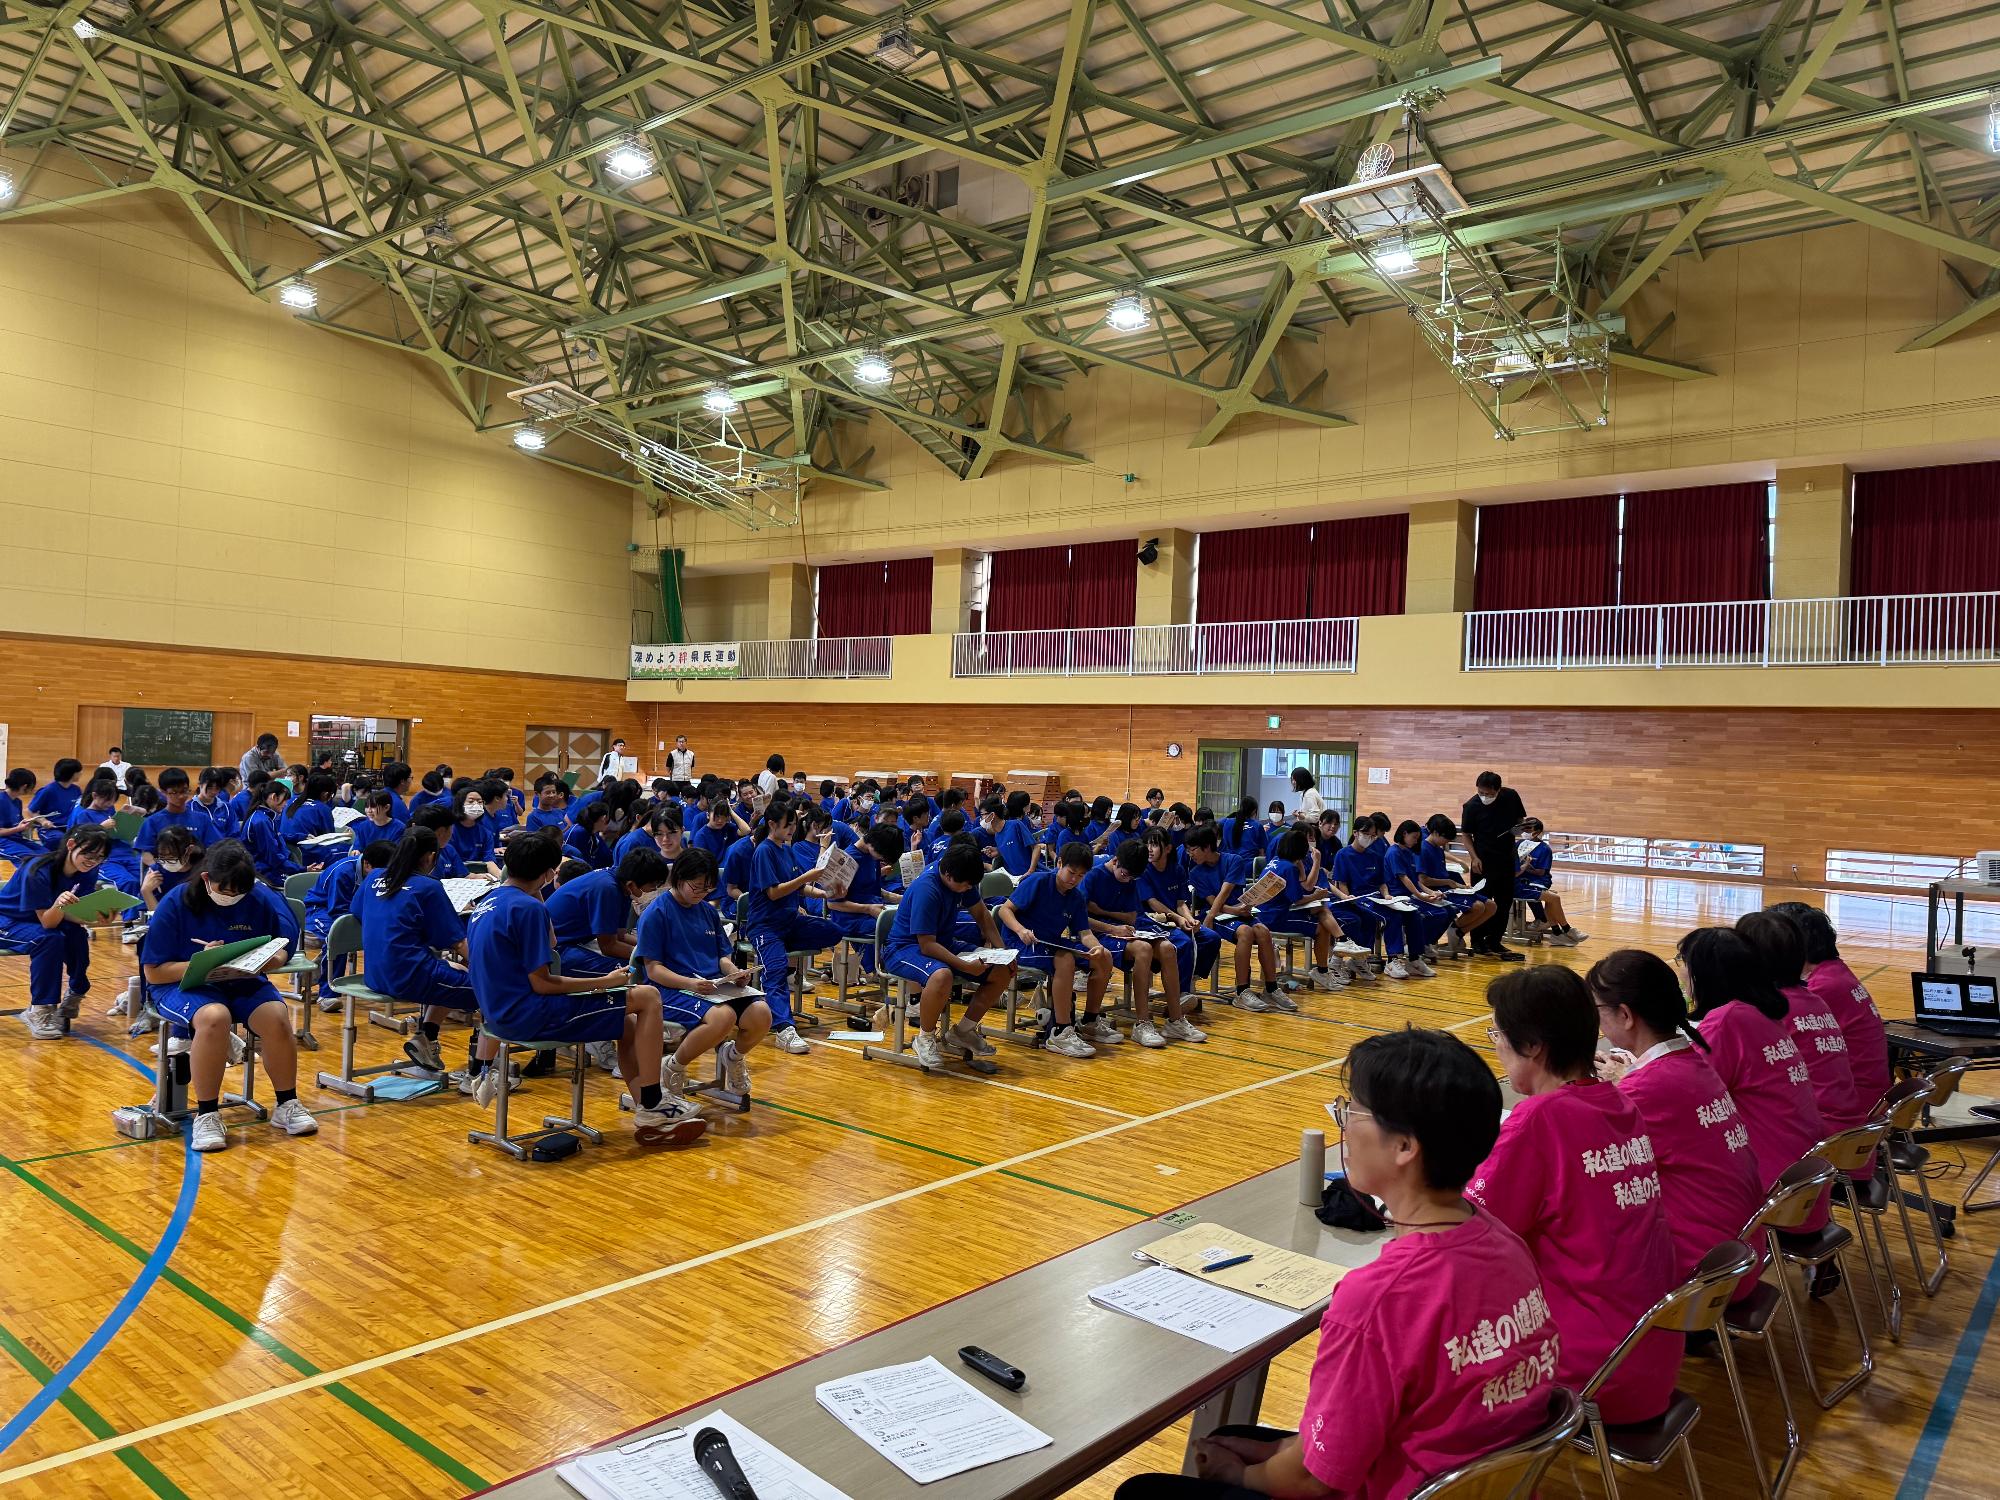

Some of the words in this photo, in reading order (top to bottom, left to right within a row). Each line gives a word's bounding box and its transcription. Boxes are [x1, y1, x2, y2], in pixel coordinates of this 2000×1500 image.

[634, 650, 736, 664] 深めよう絆県民運動
